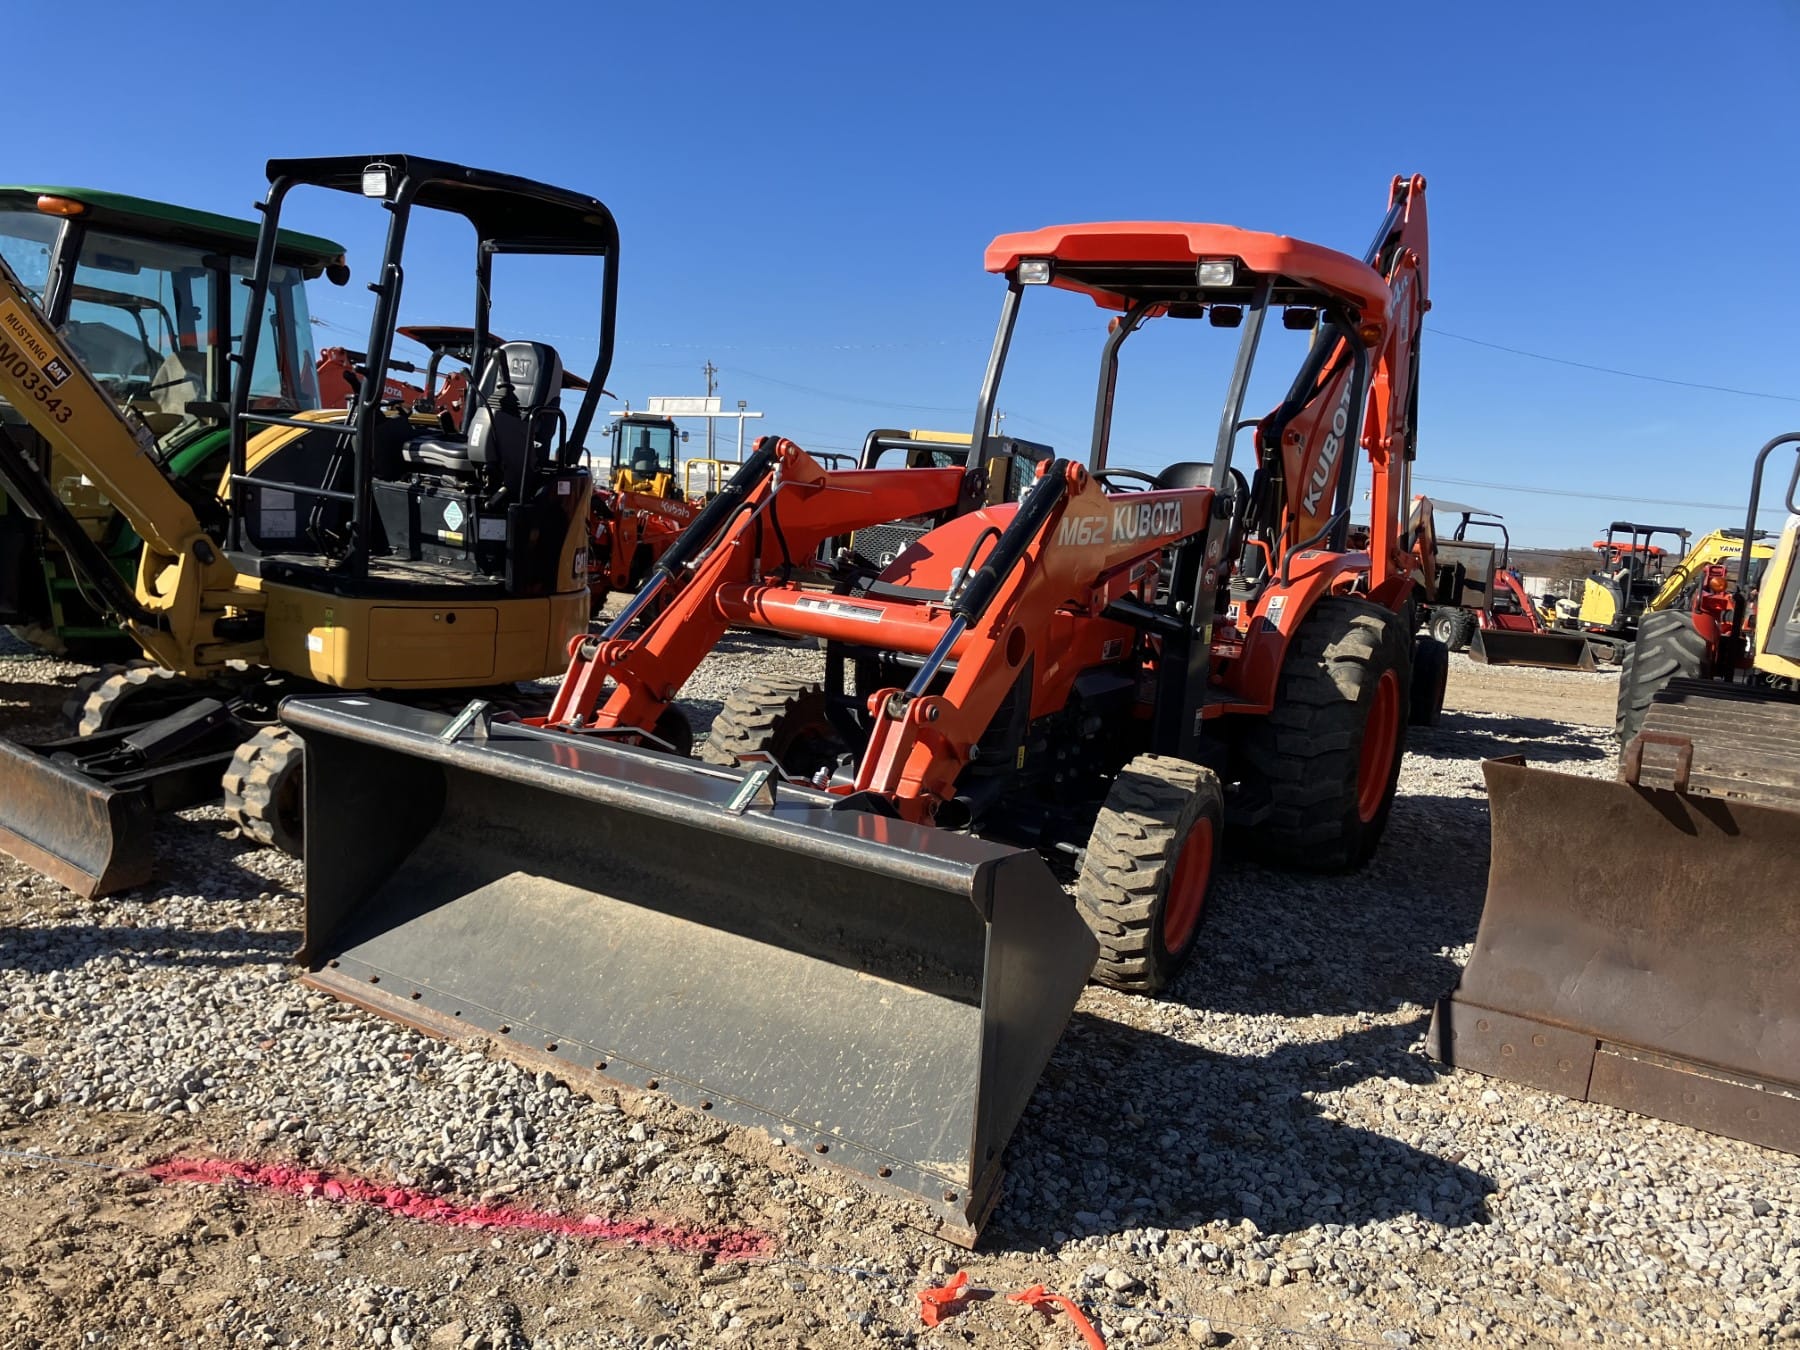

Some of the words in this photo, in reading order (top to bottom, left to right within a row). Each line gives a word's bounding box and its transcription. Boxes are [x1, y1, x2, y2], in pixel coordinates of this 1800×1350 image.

[0, 335, 72, 424] M03543
[5, 313, 48, 361] MUSTANG
[47, 361, 67, 381] CAT
[384, 385, 402, 397] OTA
[1303, 368, 1353, 516] KUBOT
[1058, 516, 1108, 546] M62
[1112, 501, 1181, 541] KUBOTA
